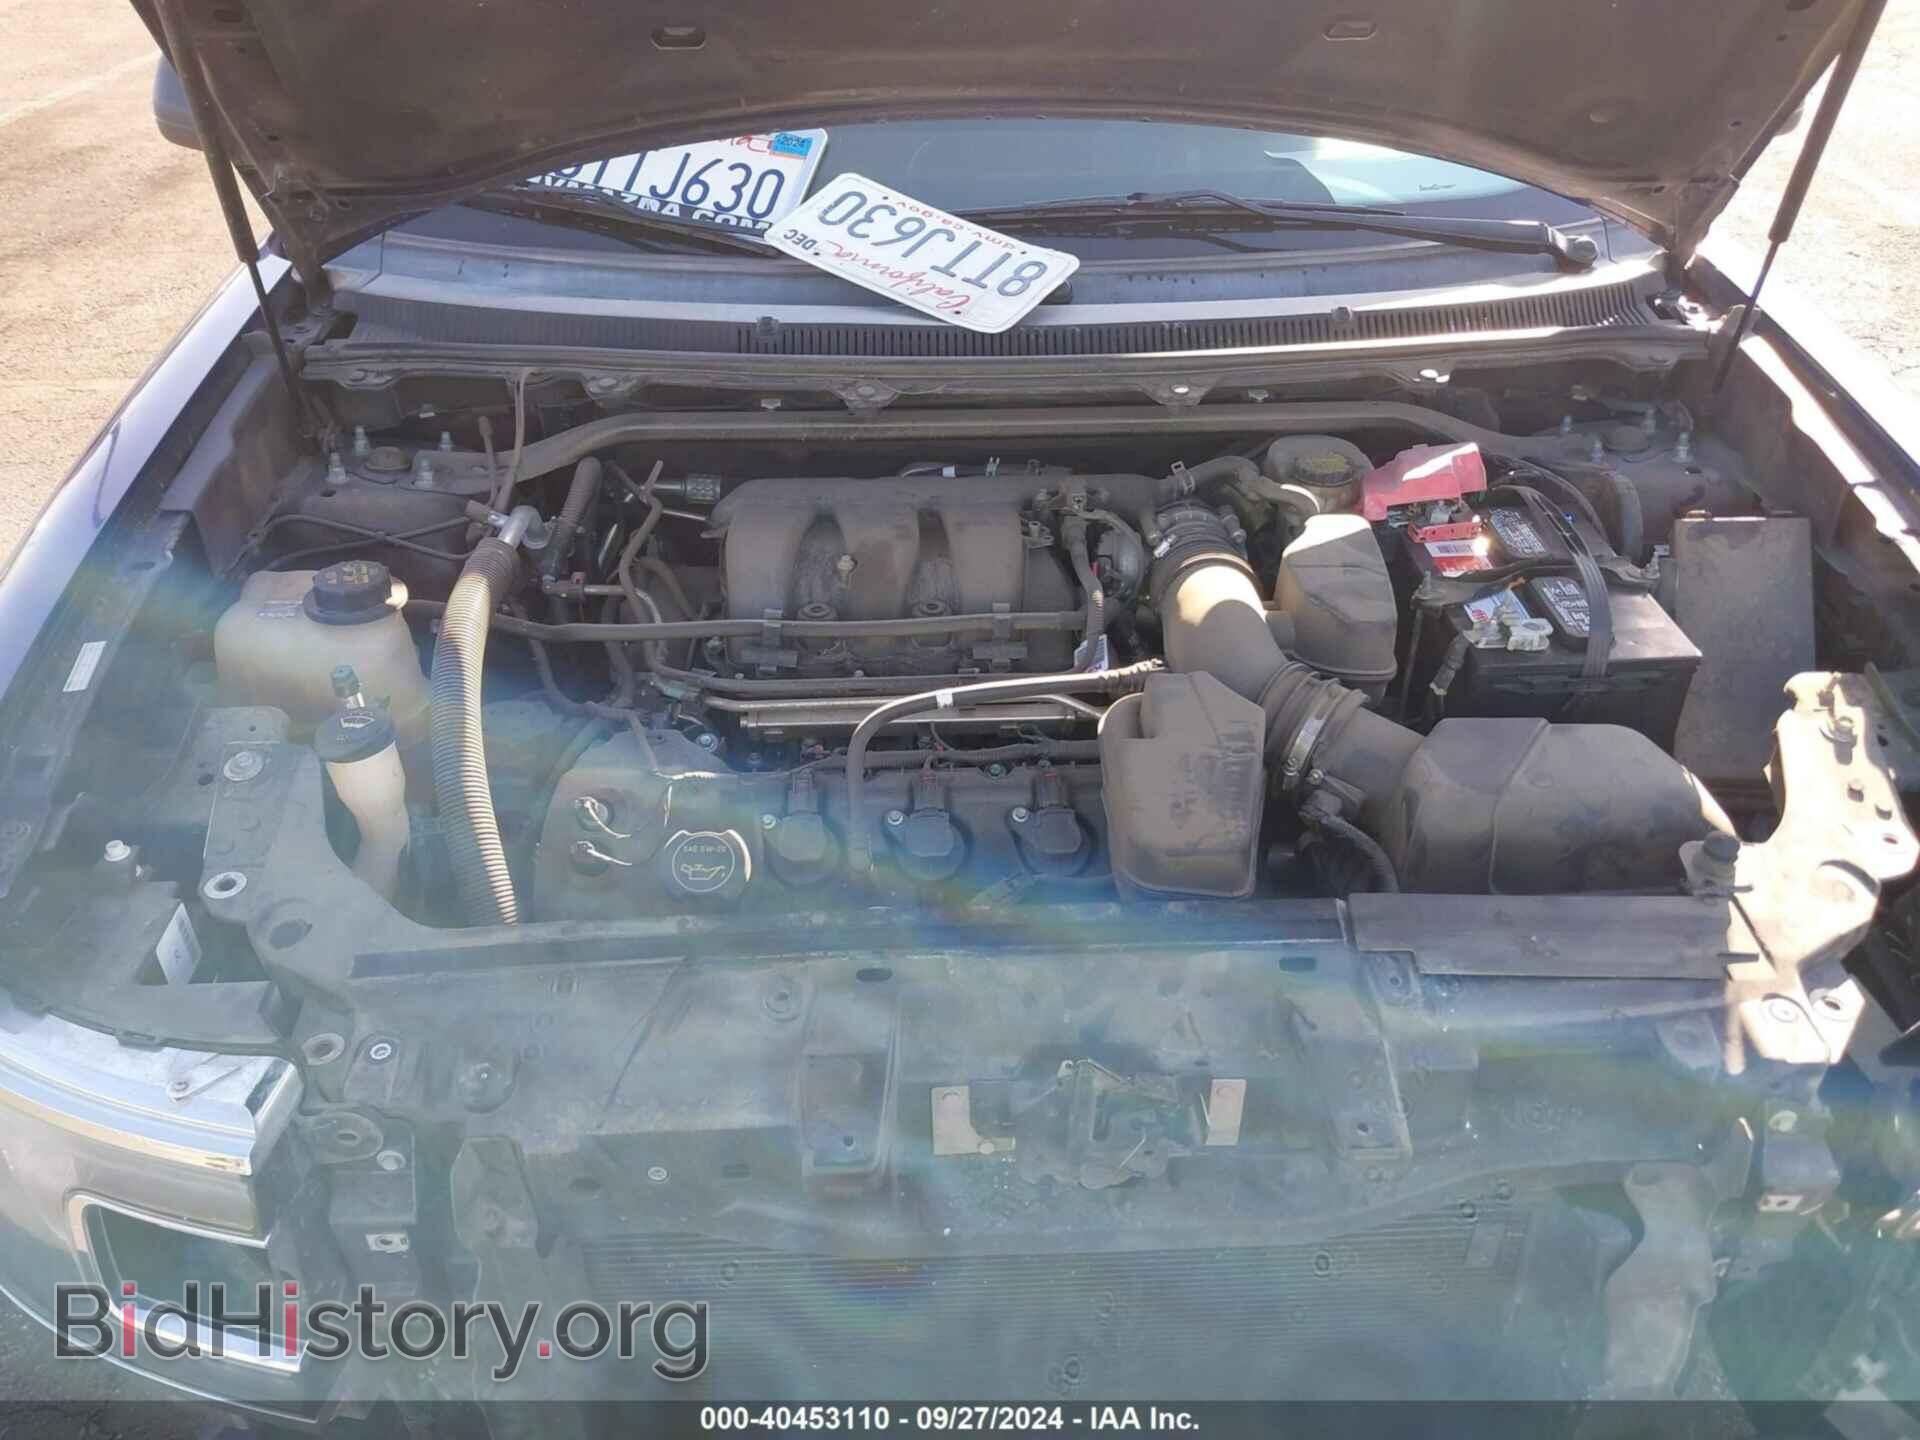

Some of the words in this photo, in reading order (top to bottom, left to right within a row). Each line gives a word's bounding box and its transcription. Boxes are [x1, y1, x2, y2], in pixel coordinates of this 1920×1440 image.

[783, 227, 816, 251] DEC
[817, 190, 1048, 297] 8TTJ630
[825, 240, 971, 310] California
